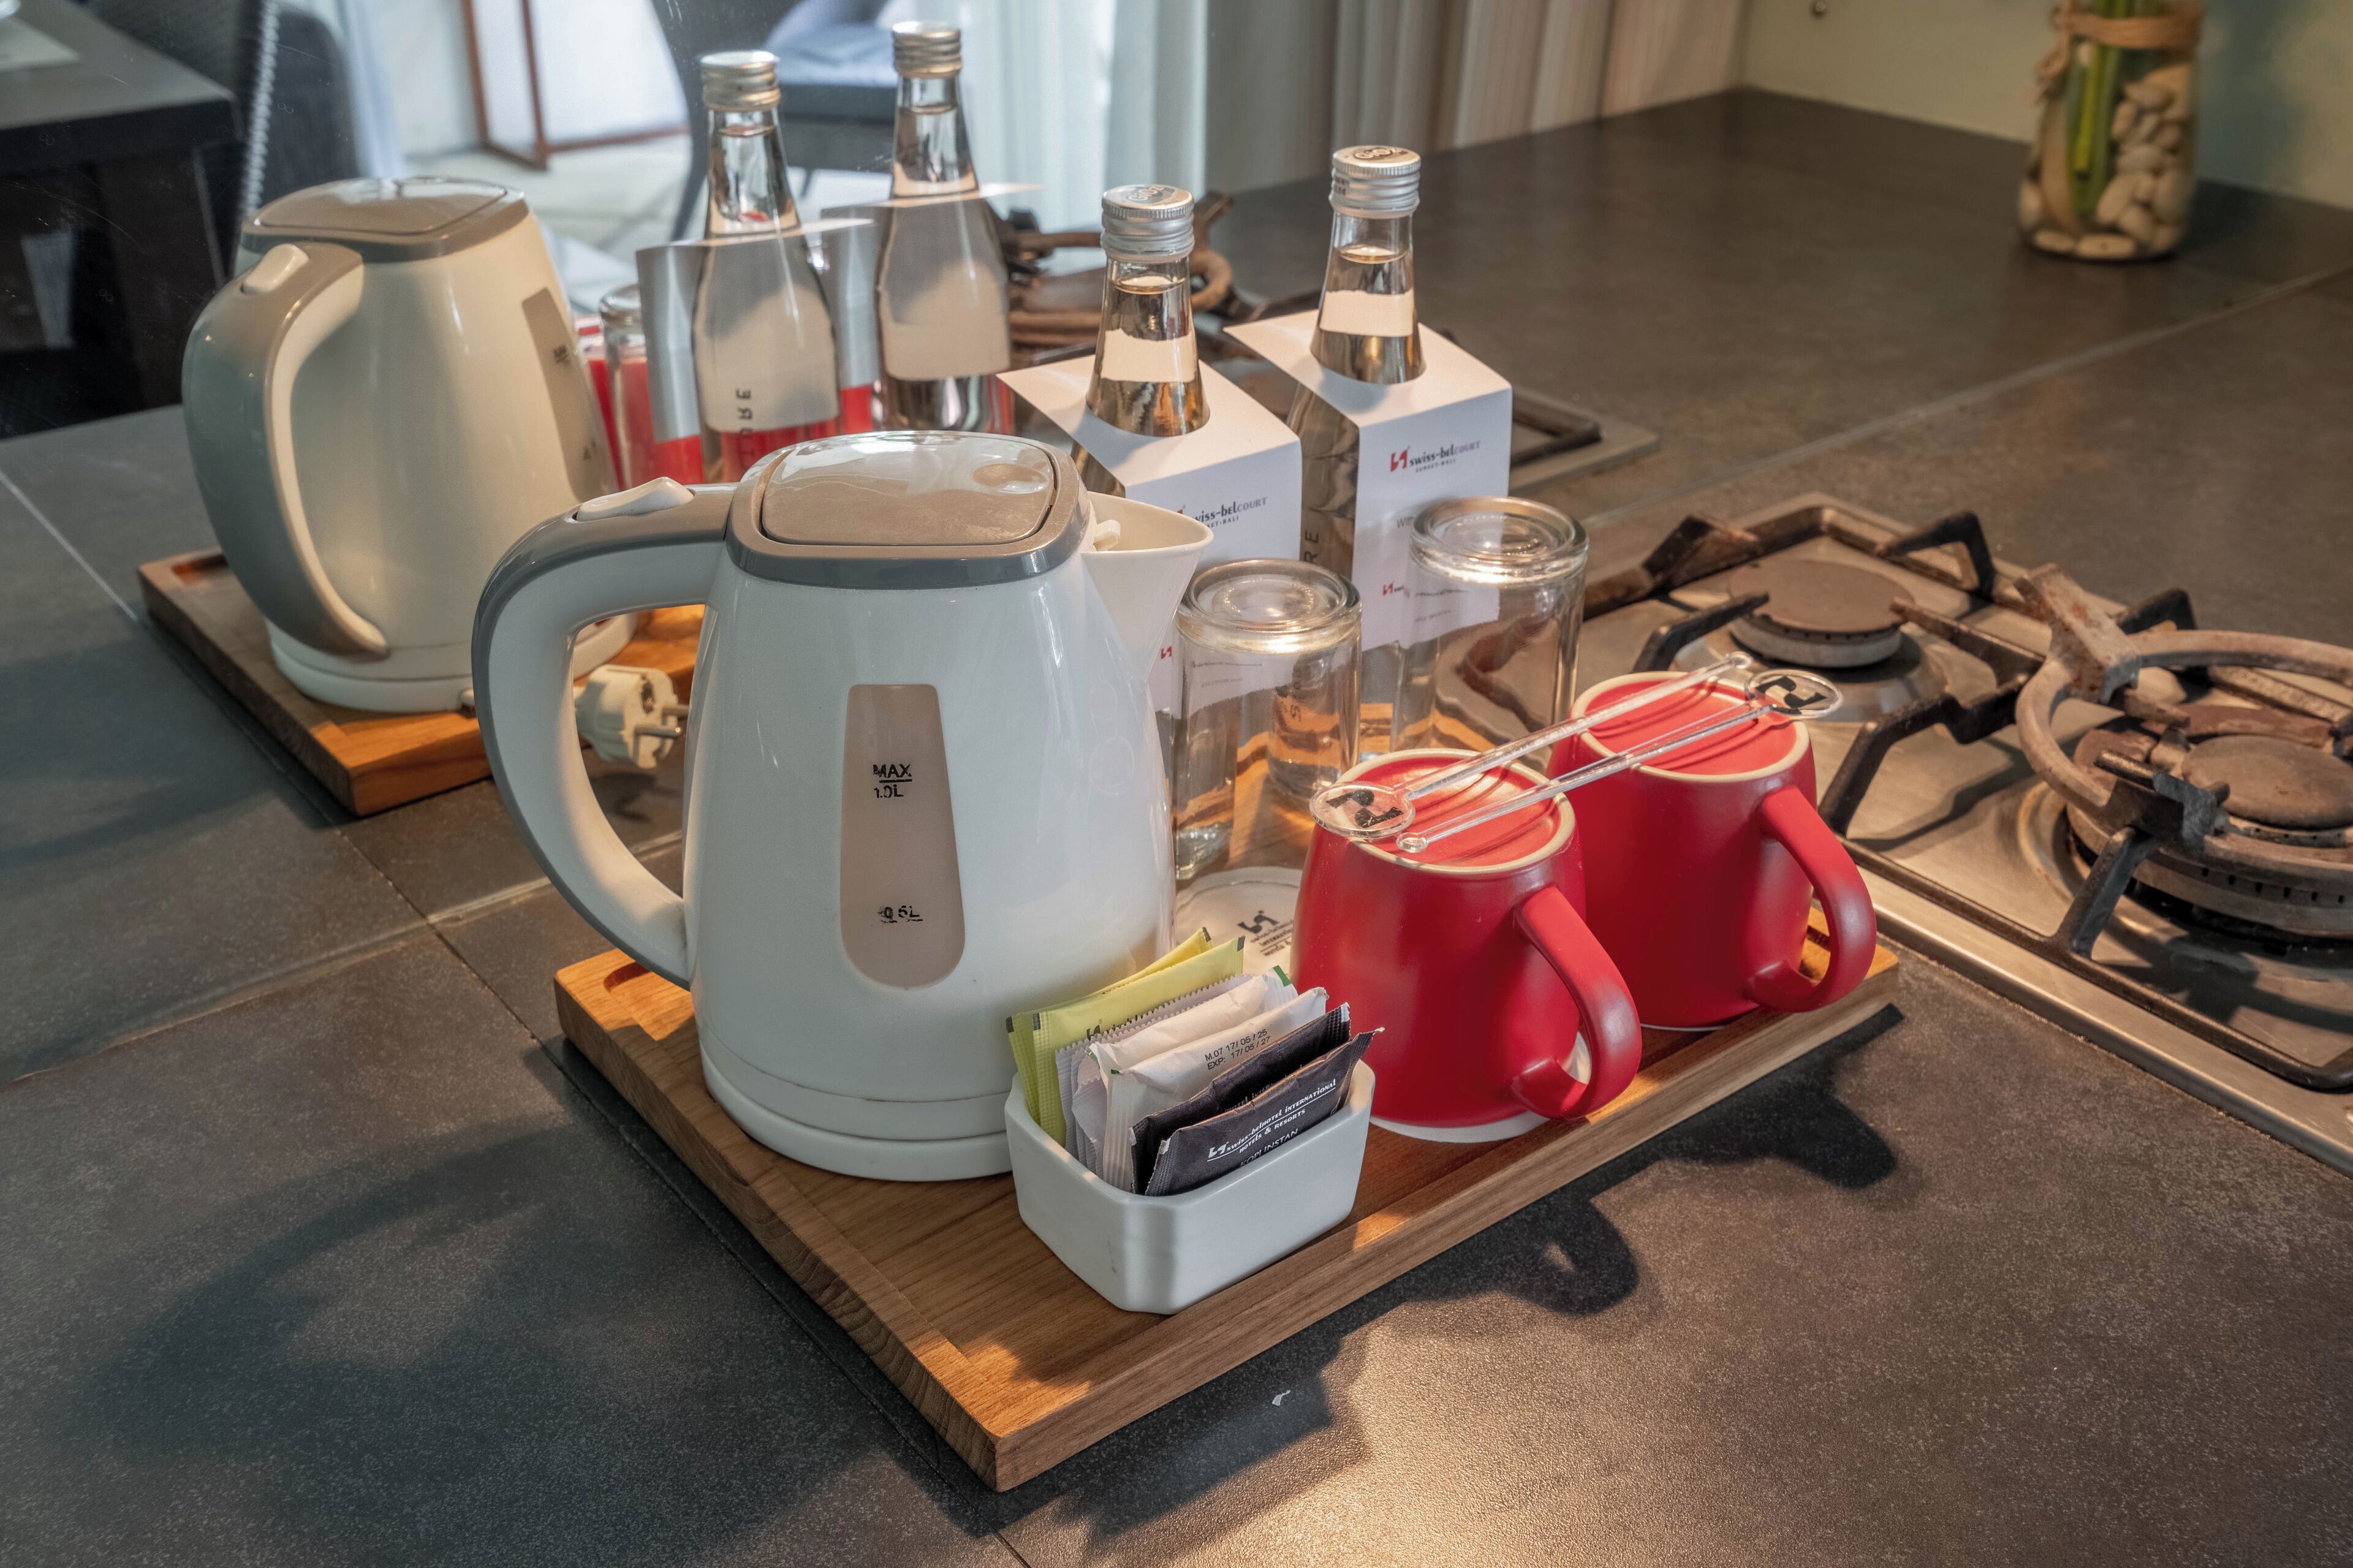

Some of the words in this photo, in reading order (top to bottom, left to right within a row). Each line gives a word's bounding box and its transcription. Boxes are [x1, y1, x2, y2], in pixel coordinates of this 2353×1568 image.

[873, 763, 912, 778] MAX
[877, 904, 920, 919] 05L
[1205, 1047, 1223, 1061] M.07
[1207, 1057, 1226, 1070] EXP:
[1264, 1127, 1271, 1135] &
[1274, 1108, 1306, 1130] RESORTS
[1240, 1149, 1262, 1167] KOPI
[1264, 1127, 1298, 1153] INSTAN
